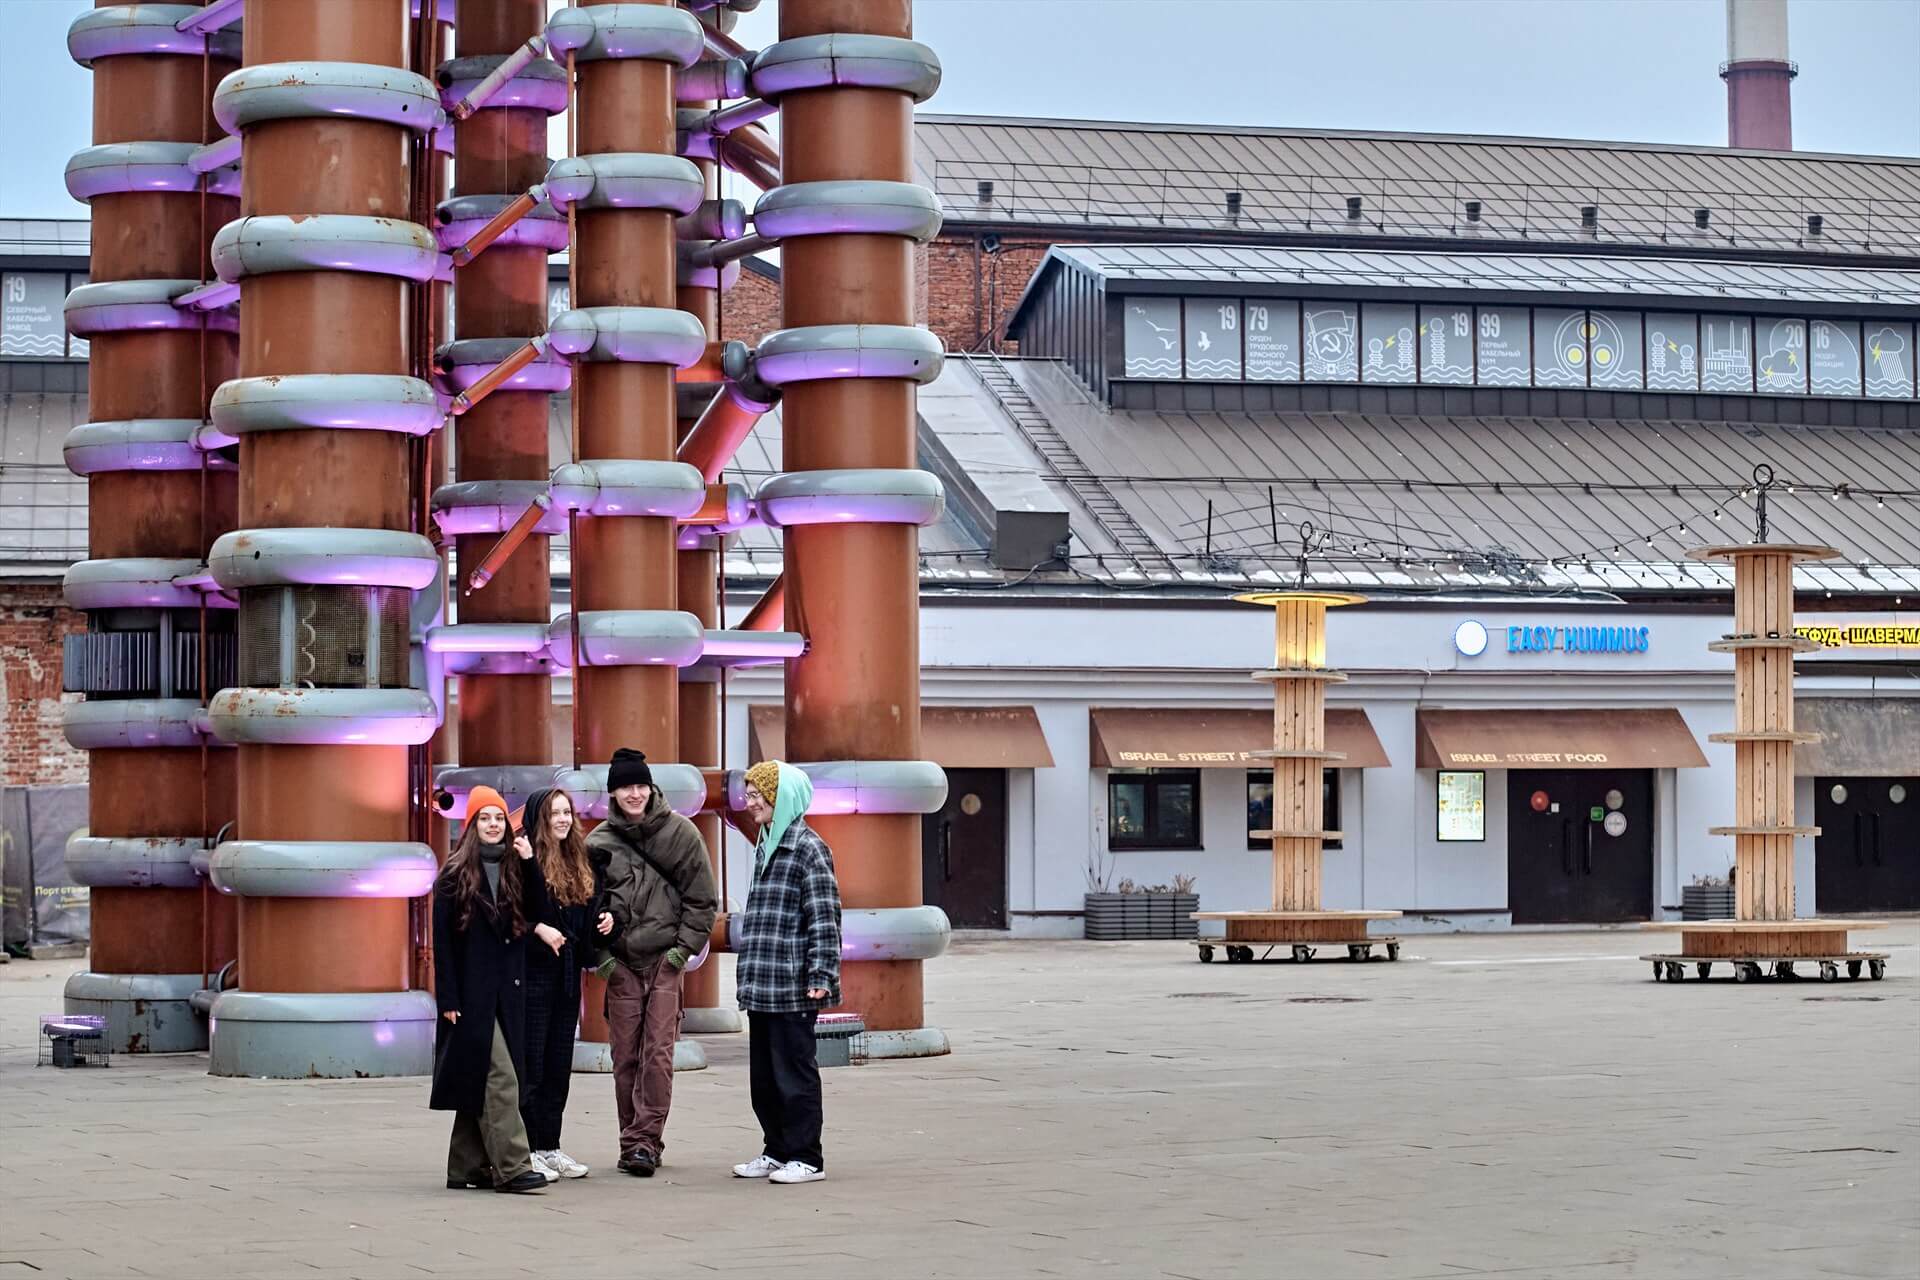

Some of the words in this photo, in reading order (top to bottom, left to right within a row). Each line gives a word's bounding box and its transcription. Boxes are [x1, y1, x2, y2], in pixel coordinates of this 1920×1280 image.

[6, 276, 25, 302] 19
[1217, 305, 1236, 330] 19
[1249, 306, 1268, 331] 79
[1451, 312, 1469, 337] 19
[1481, 313, 1500, 338] 99
[1249, 335, 1272, 343] ОРДЕН
[1249, 343, 1289, 351] ТРУДОВОГО
[1785, 324, 1803, 349] 20
[1813, 325, 1830, 350] 16
[1249, 351, 1286, 359] КРАСНОГО
[1507, 626, 1556, 653] EASY
[1563, 626, 1649, 653] HUMMUS
[1119, 751, 1175, 761] ISRAEL
[1178, 751, 1235, 761] STREET
[1450, 753, 1503, 763] ISRAEL
[1507, 753, 1561, 763] STREET
[1565, 753, 1608, 763] FOOD
[35, 886, 60, 897] Порт
